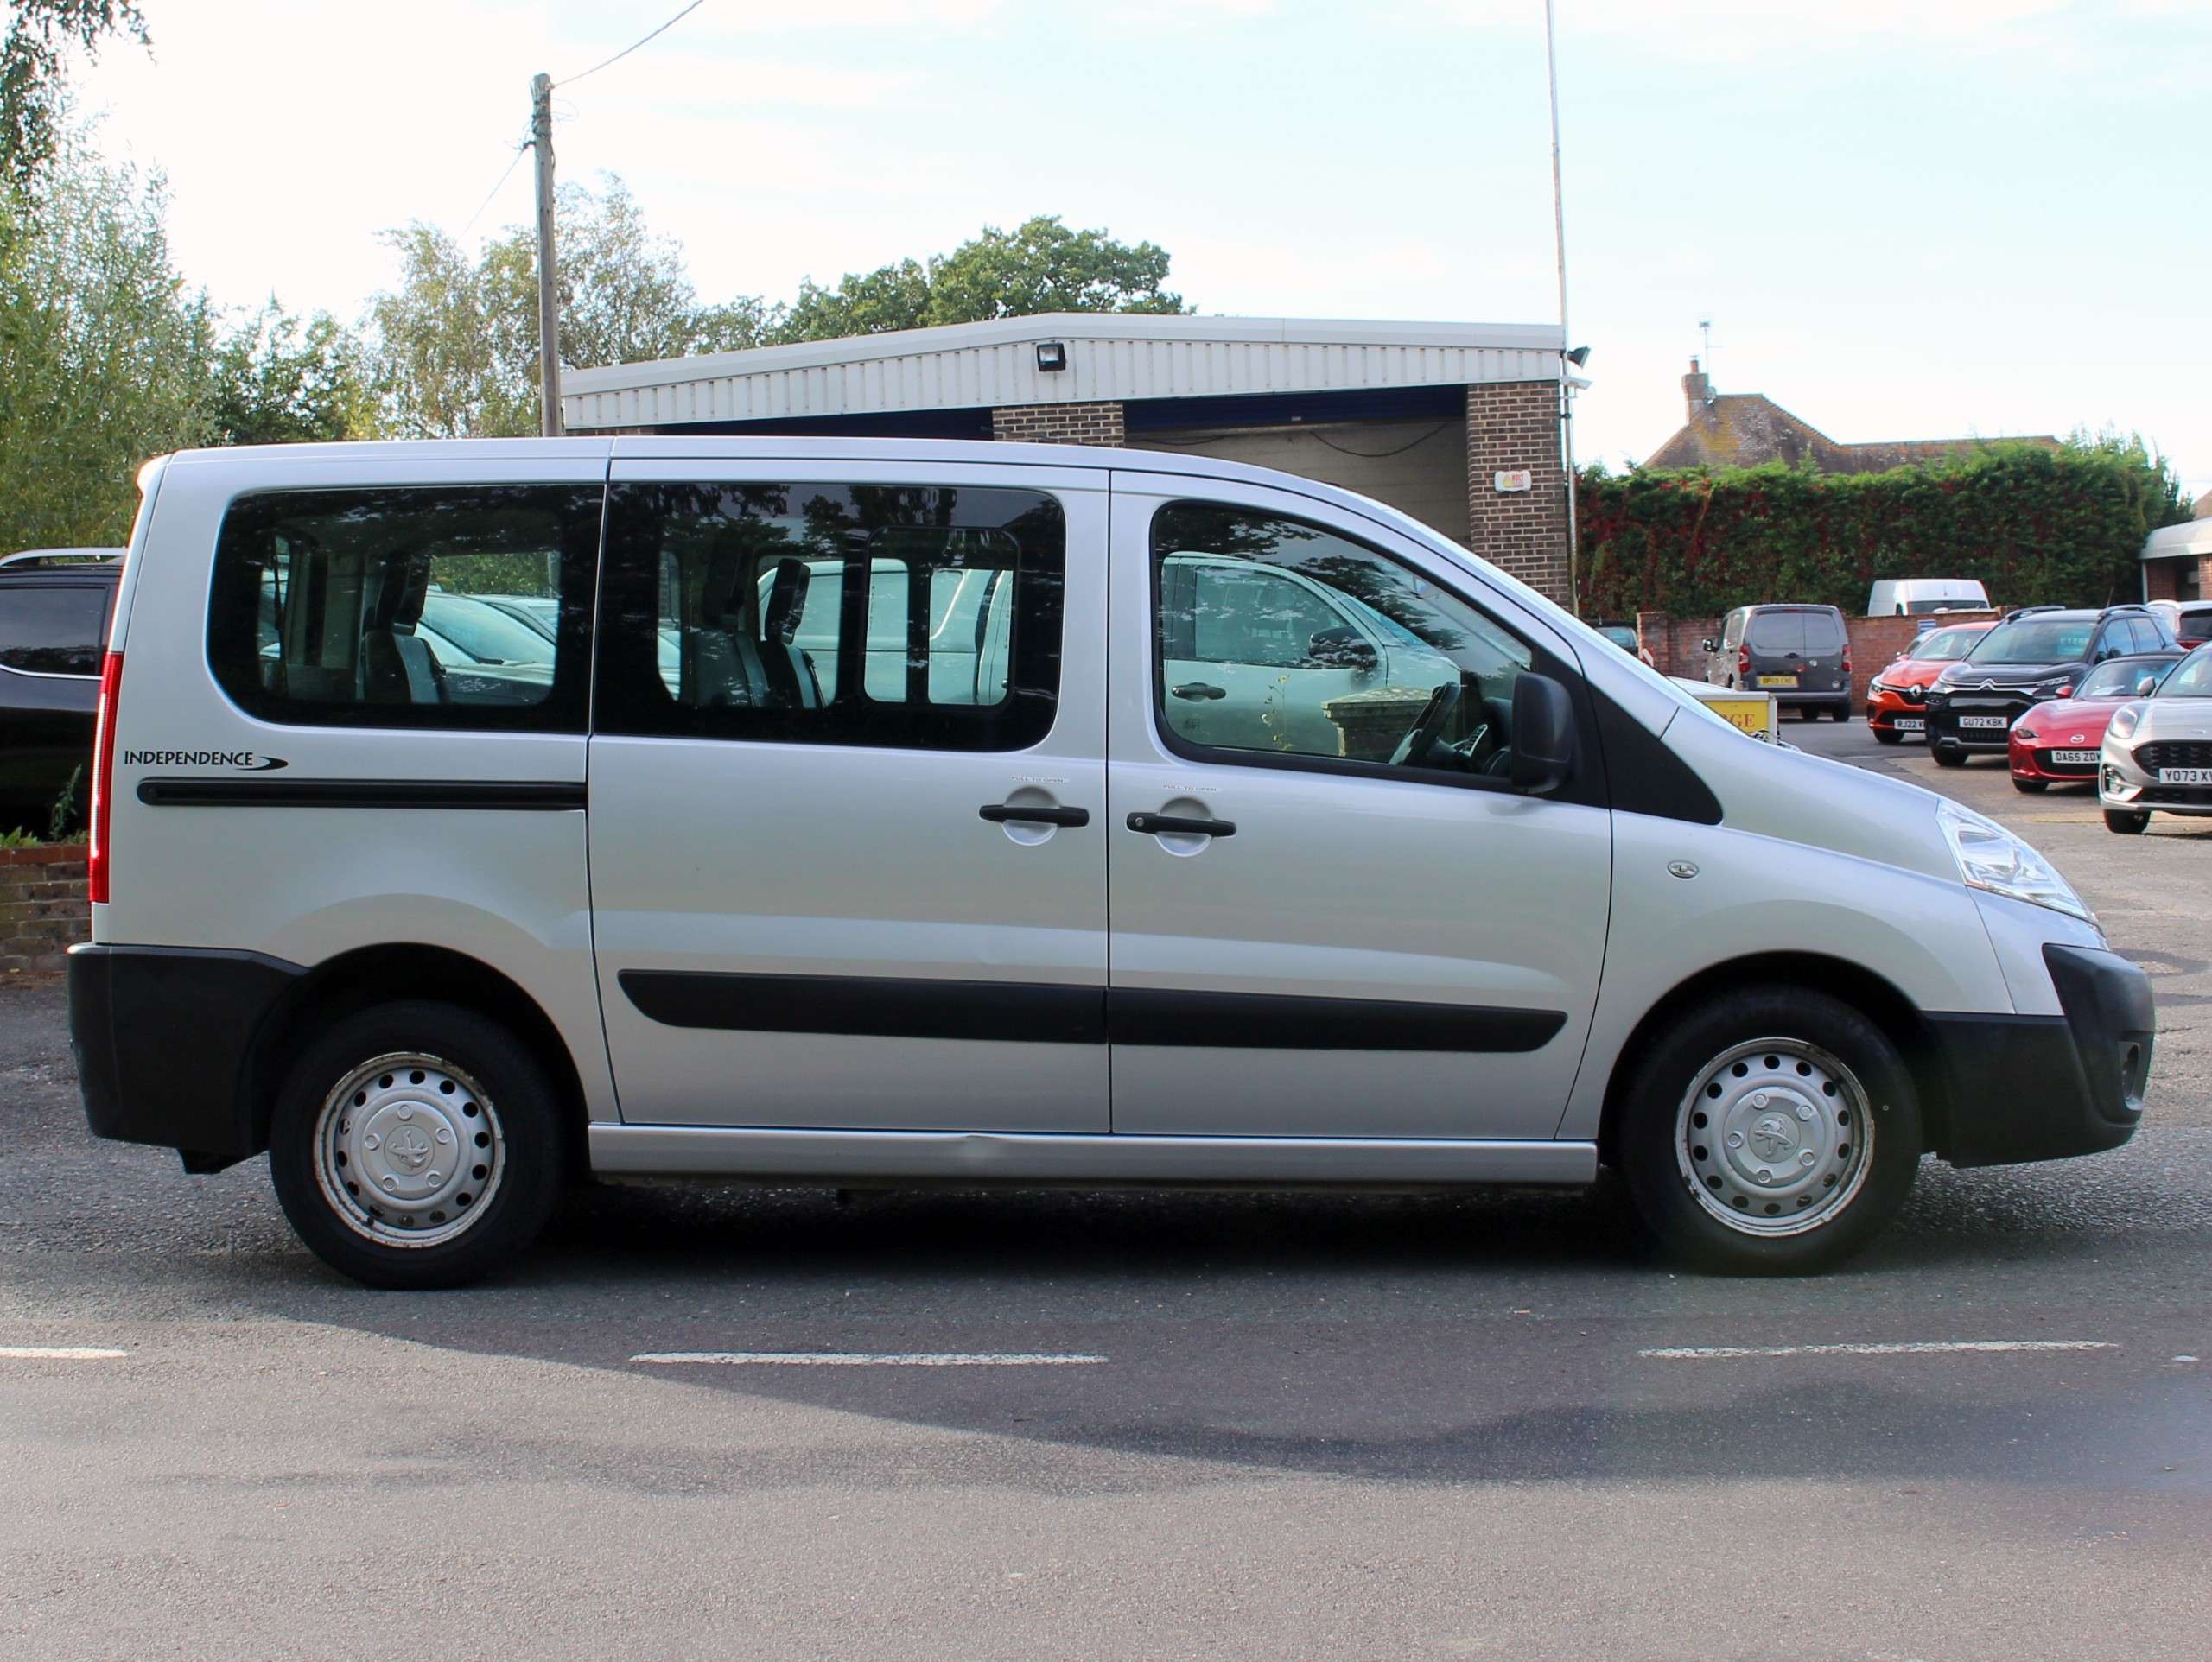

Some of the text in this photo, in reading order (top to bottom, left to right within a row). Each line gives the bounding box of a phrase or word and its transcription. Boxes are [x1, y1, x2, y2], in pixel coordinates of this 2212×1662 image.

[1962, 718, 1984, 726] GU72
[124, 750, 253, 766] INDEPENDENCE
[2056, 752, 2082, 762] DA65
